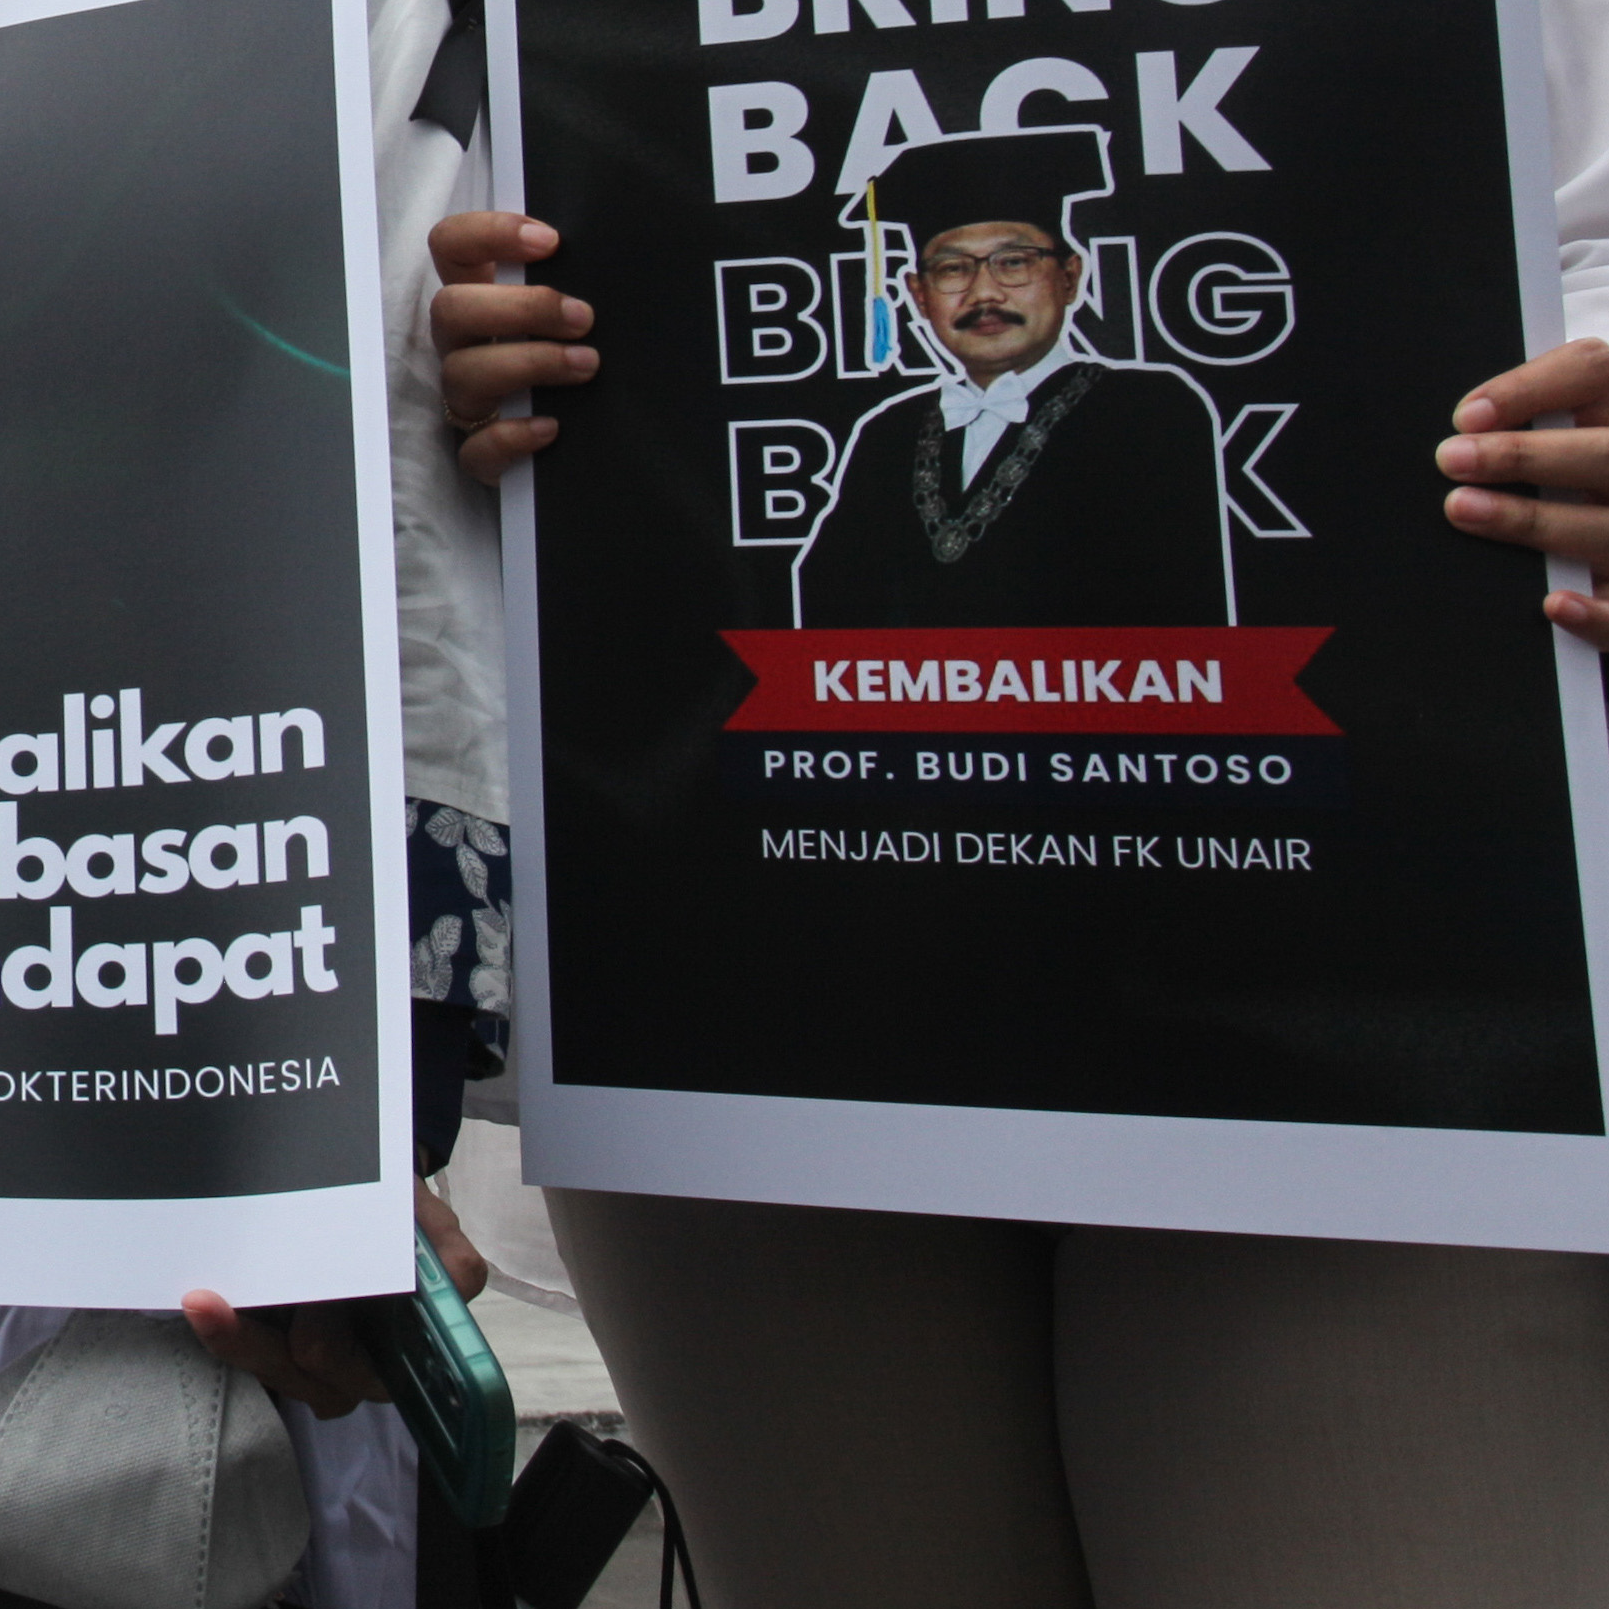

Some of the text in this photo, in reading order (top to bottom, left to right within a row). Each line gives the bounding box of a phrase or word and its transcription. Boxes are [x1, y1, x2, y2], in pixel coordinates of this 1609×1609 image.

[814, 660, 1224, 704] KEMBALIKAN
[764, 750, 1292, 785] PROF. BUDI SANTOSO
[762, 828, 1312, 871] MENJADI DEKAN FK UNAIR
